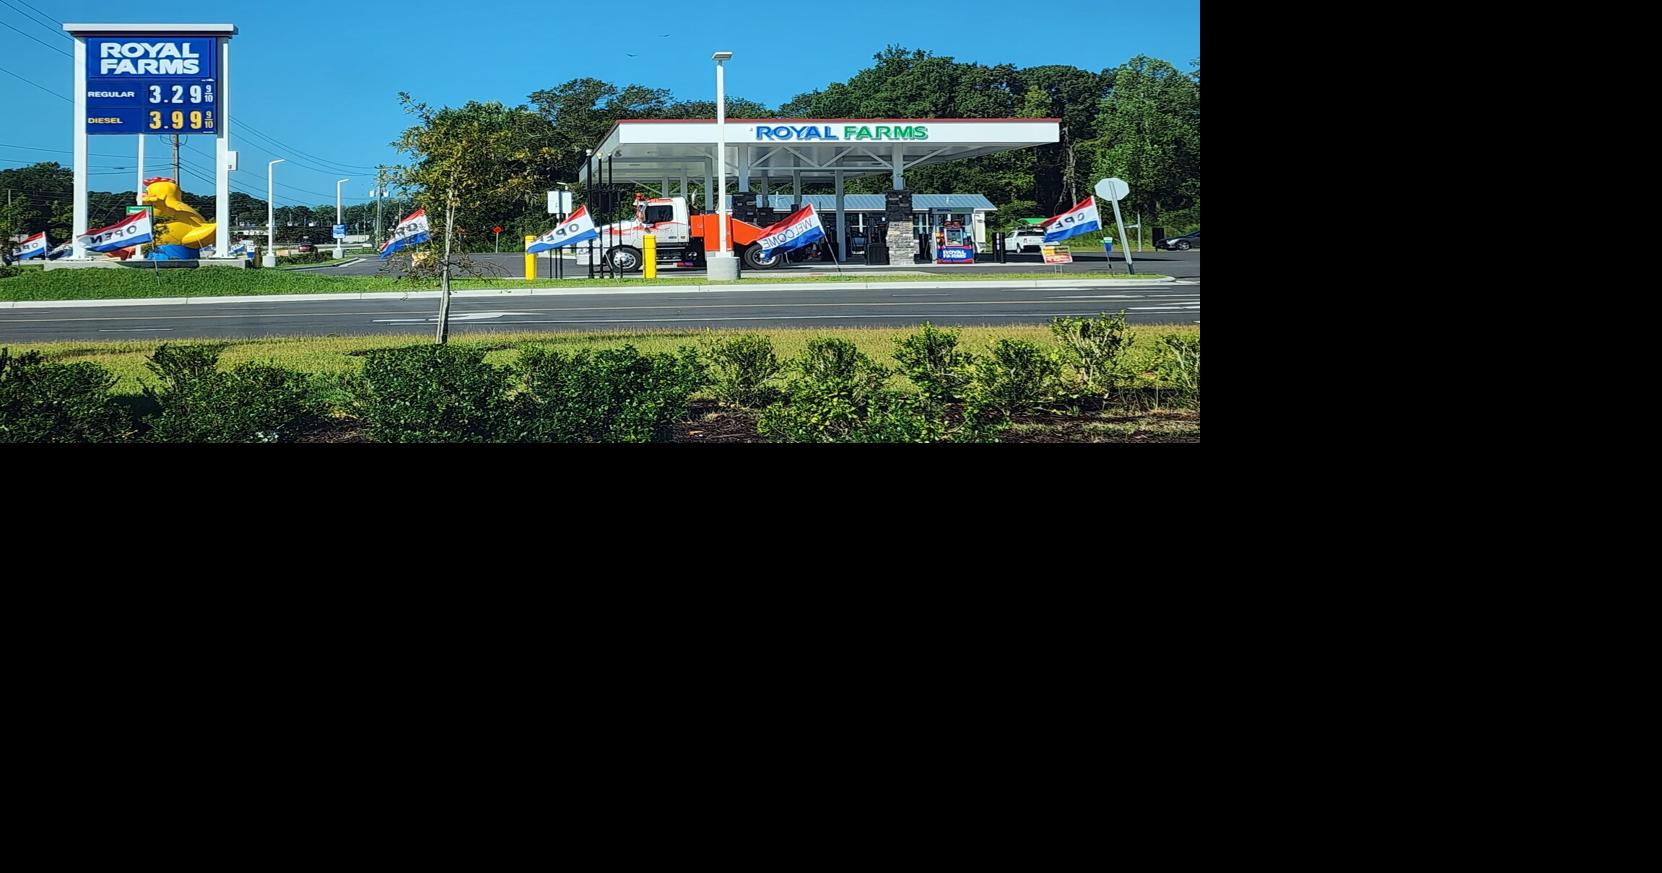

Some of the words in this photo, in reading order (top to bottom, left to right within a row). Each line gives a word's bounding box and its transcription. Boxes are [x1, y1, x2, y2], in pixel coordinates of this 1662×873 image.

[100, 42, 200, 58] ROYAL
[100, 59, 200, 75] FARMS
[149, 85, 202, 103] 3.29
[149, 111, 202, 129] 3.99
[756, 125, 839, 140] ROYAL
[844, 125, 928, 140] FARMS
